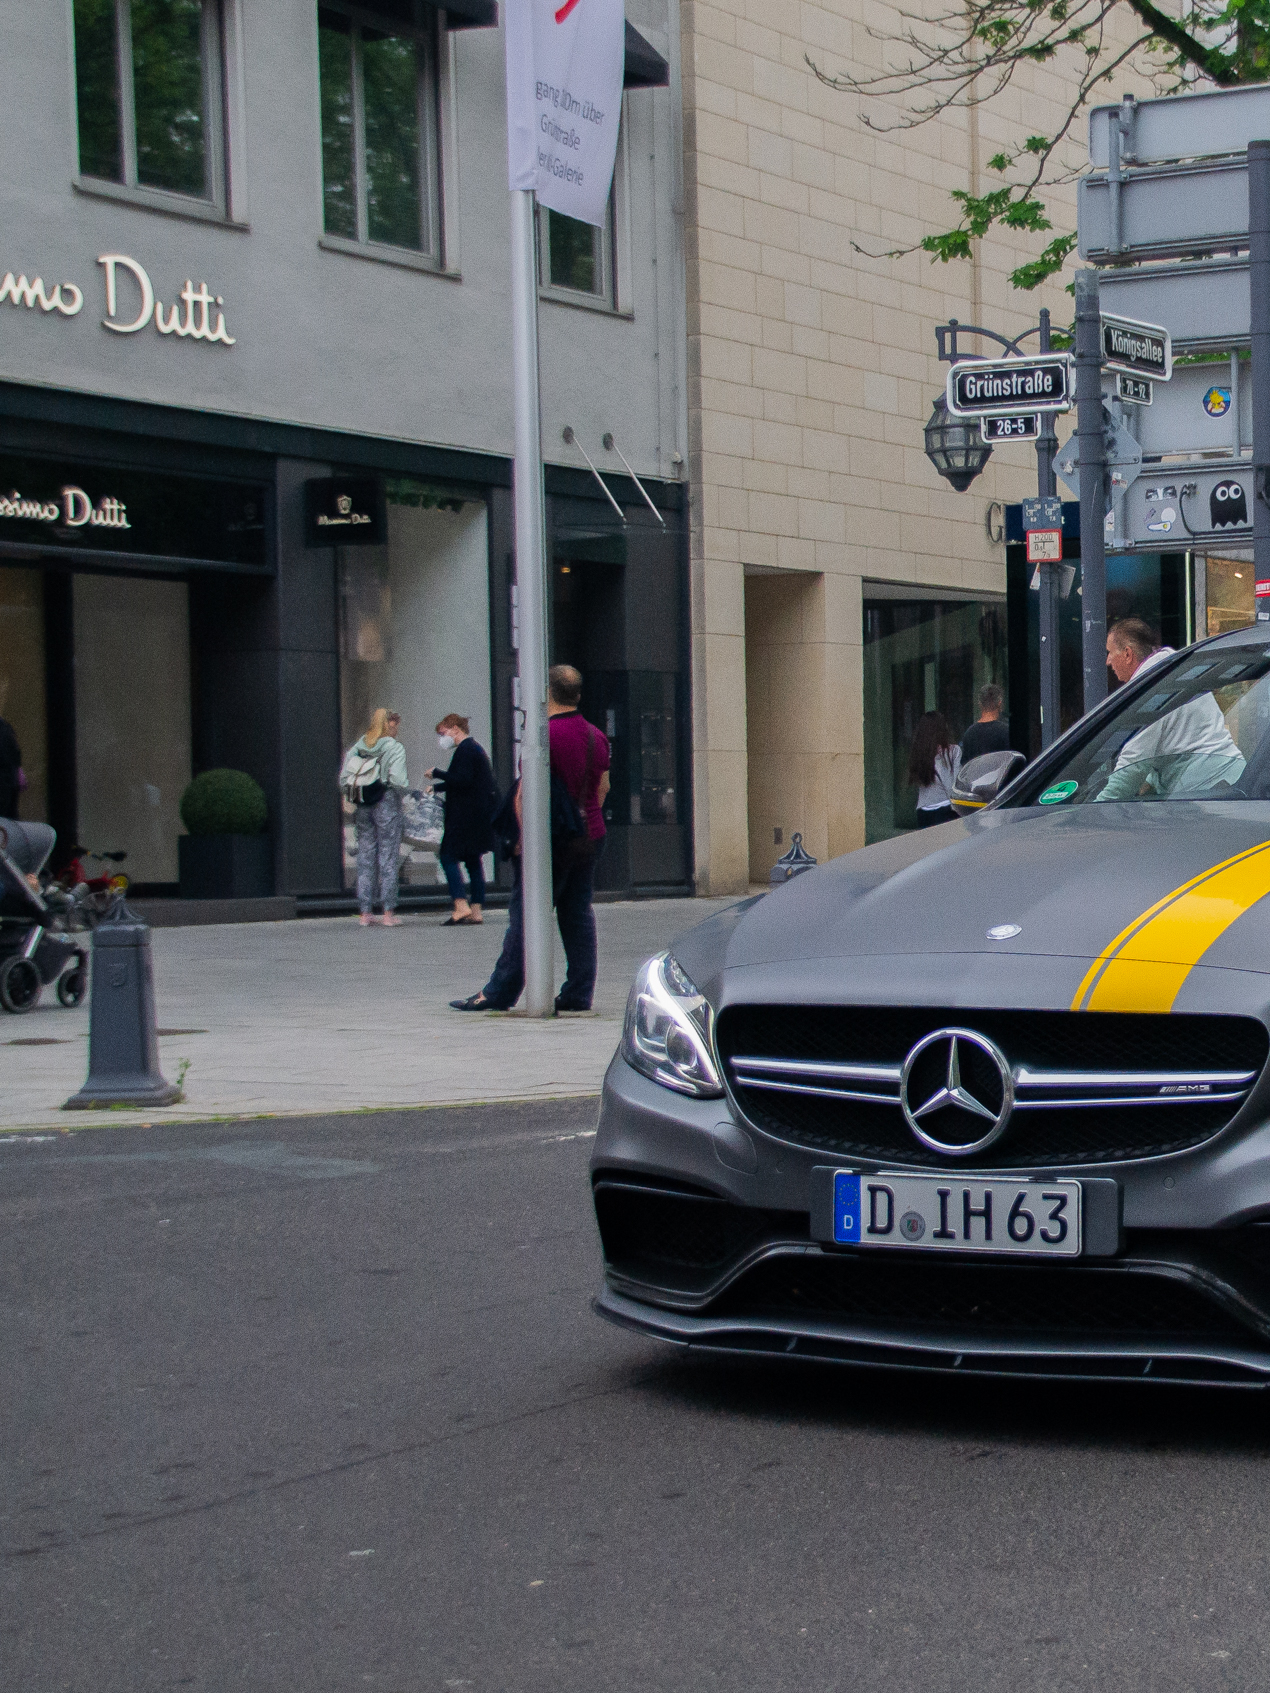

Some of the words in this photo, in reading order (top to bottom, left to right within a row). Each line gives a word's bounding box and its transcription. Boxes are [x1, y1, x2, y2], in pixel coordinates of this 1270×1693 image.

[96, 255, 237, 345] Dutti
[1110, 328, 1163, 363] Königsallee
[965, 370, 1053, 399] Grünstraße
[996, 418, 1026, 436] 26-5
[62, 486, 132, 528] Dutti
[843, 1214, 854, 1230] D
[867, 1183, 895, 1234] D
